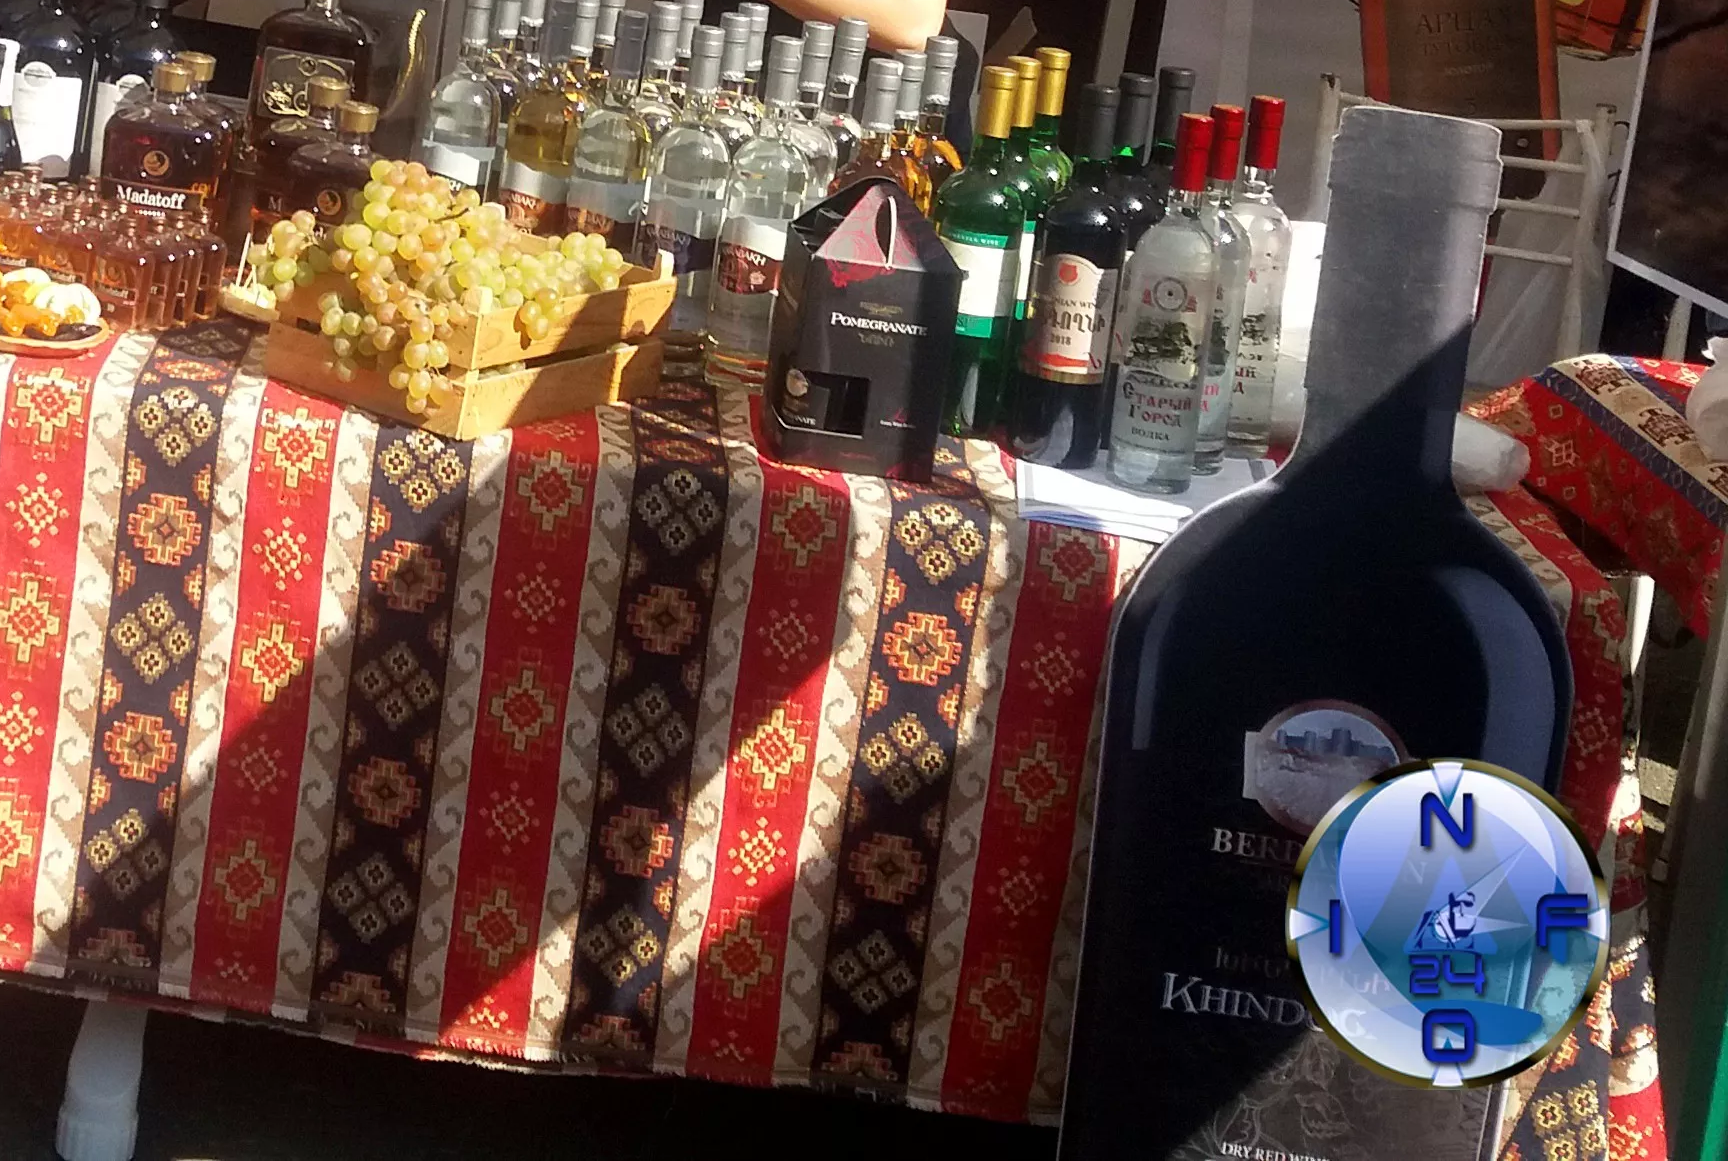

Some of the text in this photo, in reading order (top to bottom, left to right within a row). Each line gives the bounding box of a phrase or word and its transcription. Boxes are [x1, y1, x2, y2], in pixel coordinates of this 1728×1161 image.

[116, 184, 186, 210] Madatoff
[830, 311, 928, 337] POMEGRANATE
[1221, 1141, 1253, 1160] DRY
[1255, 1147, 1286, 1161] RED
